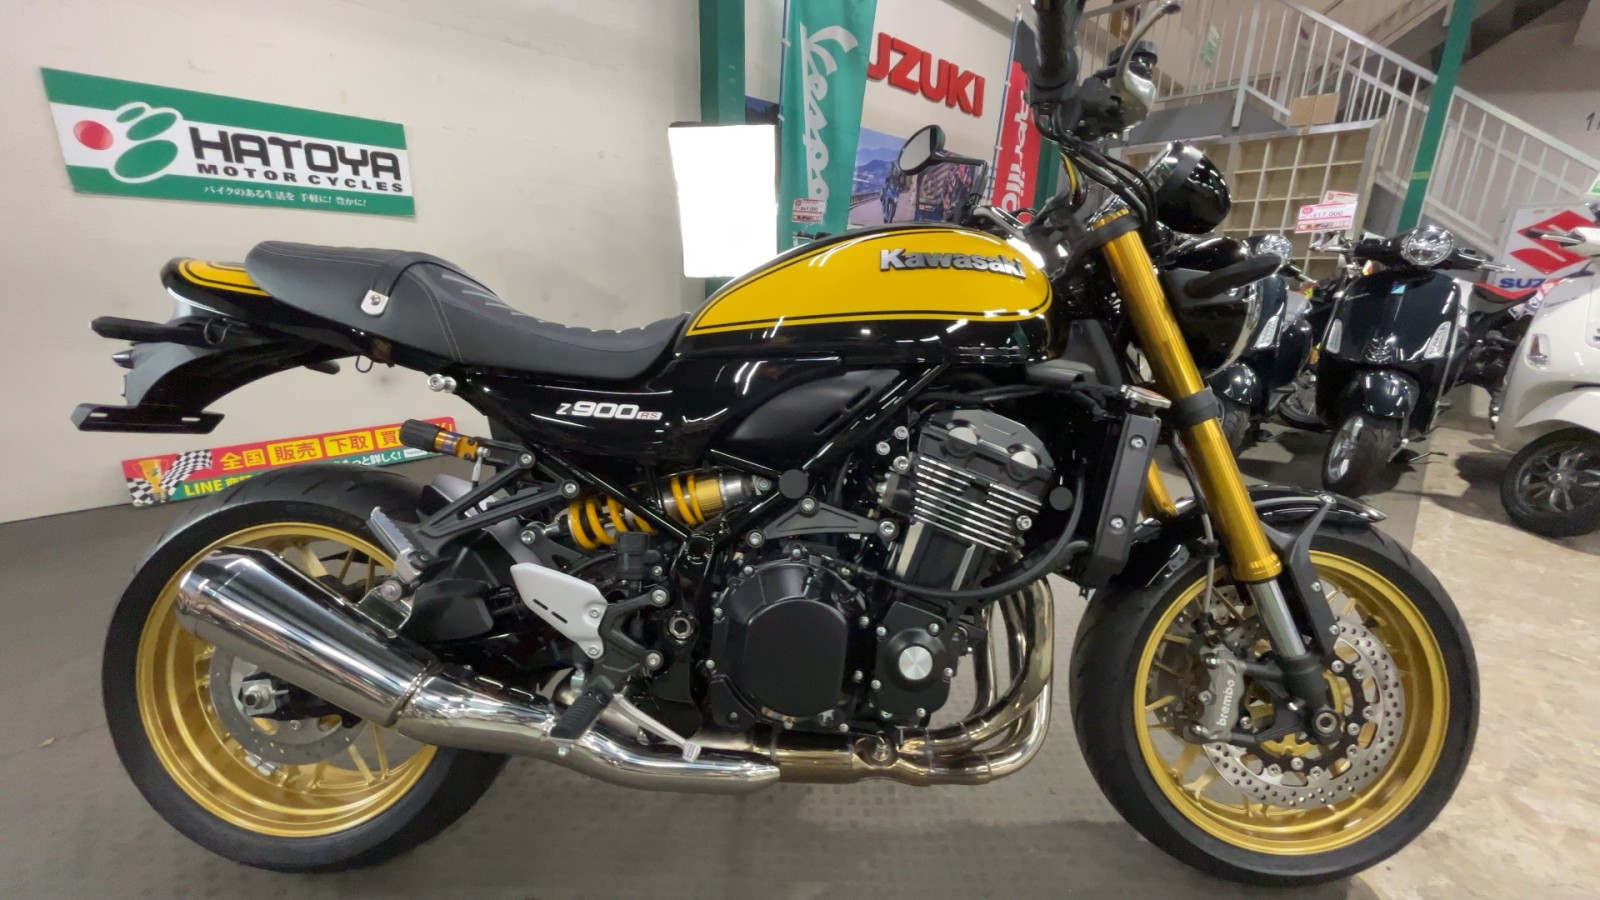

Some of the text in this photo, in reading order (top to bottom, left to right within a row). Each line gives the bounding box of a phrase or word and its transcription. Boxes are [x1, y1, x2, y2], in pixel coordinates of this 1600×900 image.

[800, 22, 859, 200] Vespa
[188, 126, 401, 180] HATOYA
[196, 163, 403, 193] MOTOR CYCLES
[880, 248, 1026, 279] Kawasaki
[220, 430, 402, 471] 全国 販売 下取 買
[184, 479, 223, 497] LINE
[1216, 679, 1235, 727] brembo
